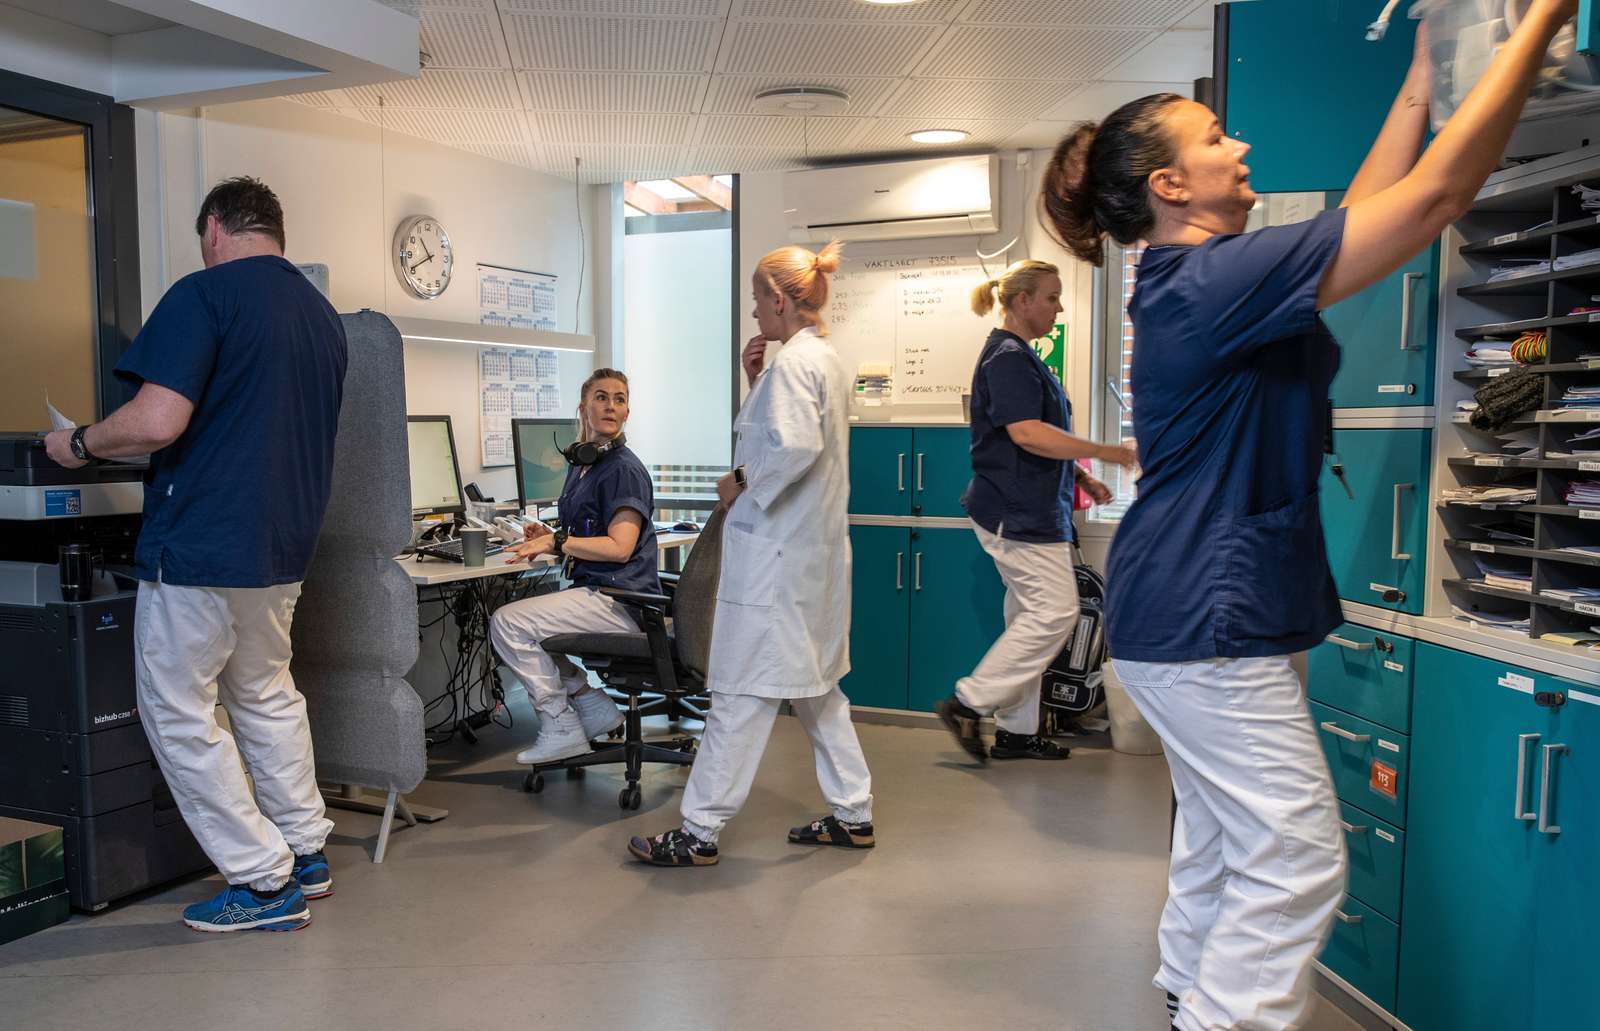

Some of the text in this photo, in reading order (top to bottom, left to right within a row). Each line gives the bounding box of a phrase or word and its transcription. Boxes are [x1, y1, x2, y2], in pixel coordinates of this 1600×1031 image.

[425, 224, 431, 232] 12
[409, 236, 416, 244] 10
[407, 251, 413, 259] 9
[94, 712, 118, 724] bizhub
[1376, 771, 1389, 787] 113
